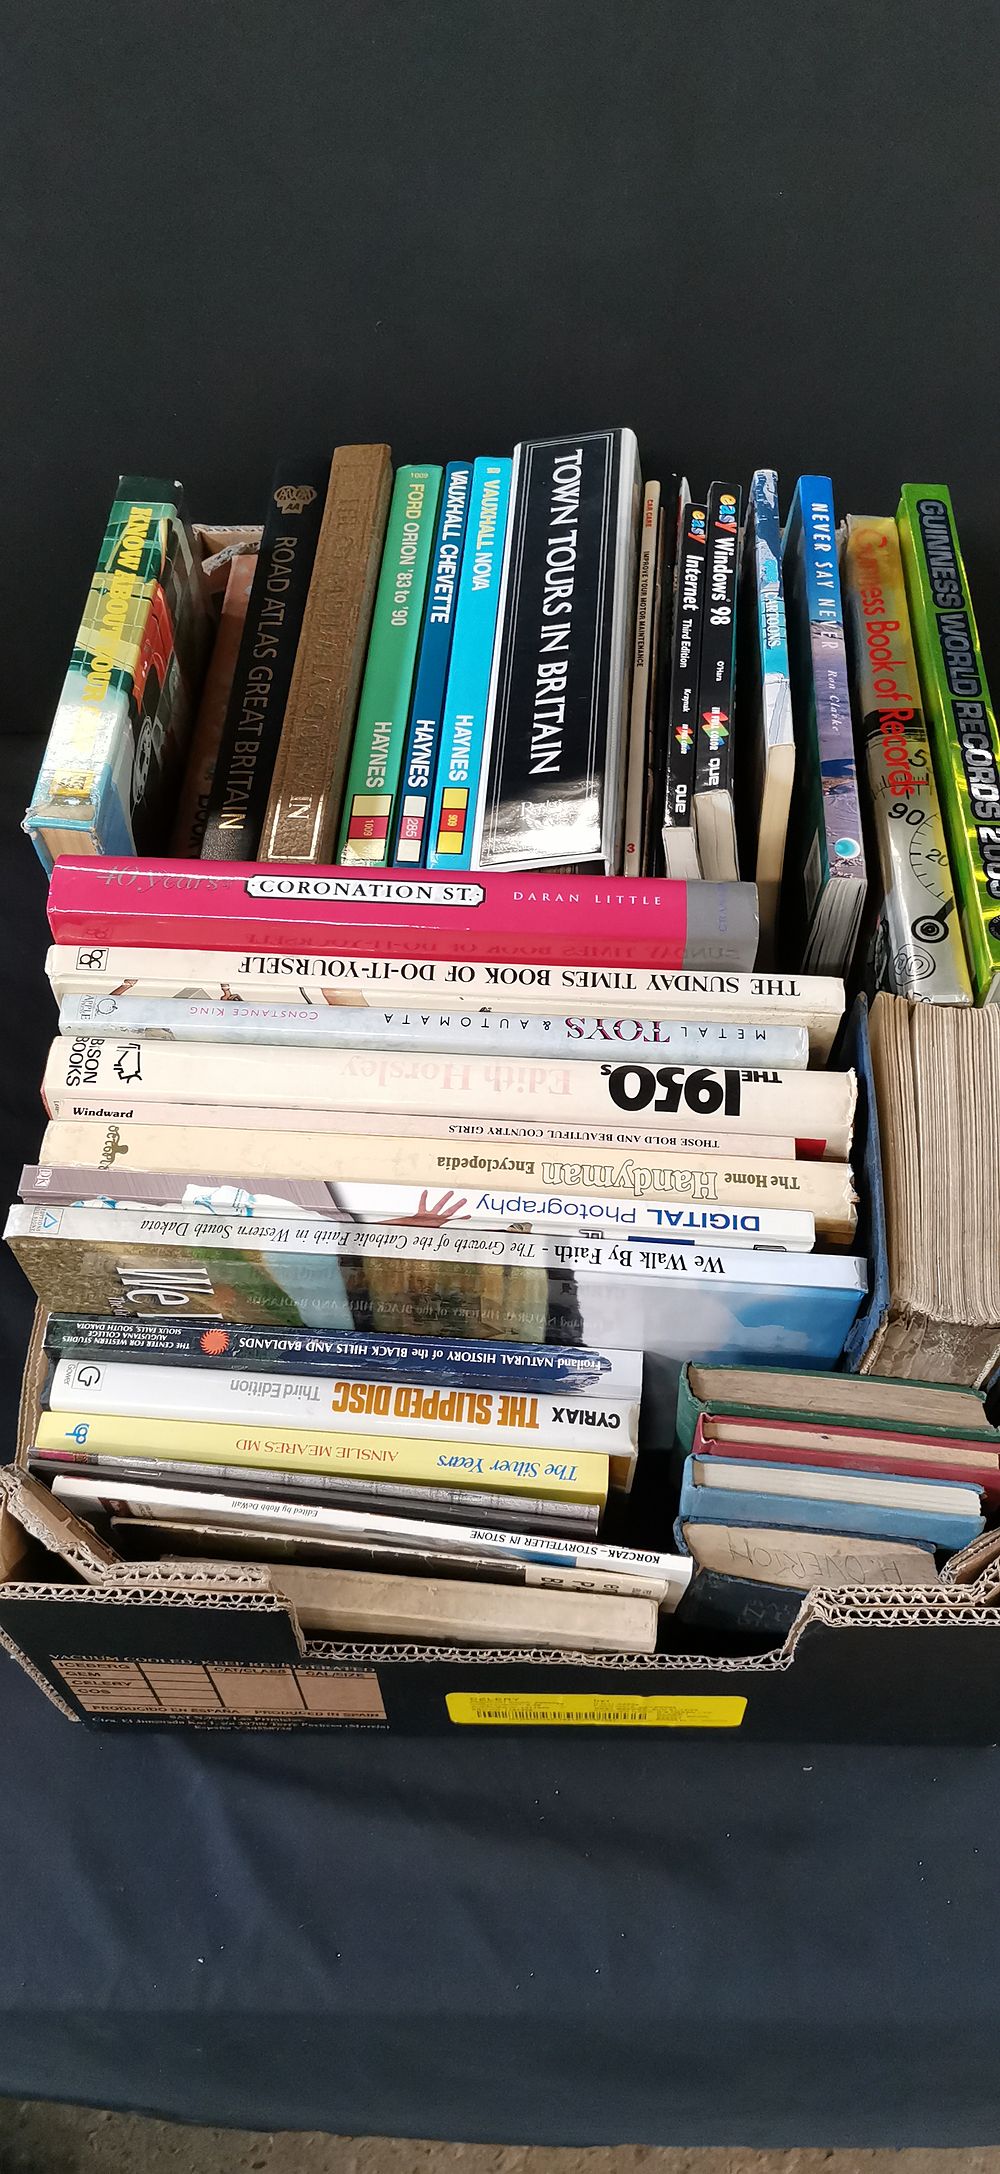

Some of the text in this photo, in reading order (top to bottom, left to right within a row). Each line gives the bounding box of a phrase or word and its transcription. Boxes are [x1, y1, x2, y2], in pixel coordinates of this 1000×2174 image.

[405, 483, 425, 520] FORD
[476, 479, 500, 551] VAUXHALL
[715, 493, 737, 533] easy
[399, 523, 420, 566] ORION
[430, 470, 469, 625] VAUXHALL CHEVETTE
[100, 506, 153, 641] KNOW ABOUT
[266, 536, 298, 593] ROAD
[471, 552, 493, 592] NOVA
[811, 502, 839, 650] NEVER SAY NEVER
[394, 590, 411, 604] to
[679, 509, 706, 668] easy Internet Third Edition
[529, 449, 583, 776] TOWN TOURS IN BRITAIN
[639, 597, 647, 619] MOTOR
[709, 606, 732, 626] 98
[252, 597, 285, 659] ATLAS
[636, 619, 646, 667] MAINTENANCE
[715, 660, 725, 682] O'Hara
[855, 527, 929, 798] Guinness Book of Records
[919, 499, 1000, 820] GUINNESS WORLD RECORDS
[237, 665, 273, 737] GREAT
[827, 669, 840, 732] Ron Clarke
[365, 721, 393, 789] HAYNES
[407, 719, 437, 788] HAYNES
[448, 714, 475, 783] HAYNES
[218, 741, 260, 830] BRITAIN
[405, 817, 420, 838] 285
[888, 802, 925, 826] 90
[626, 842, 636, 854] 3
[259, 879, 473, 901] CORONATION ST.
[513, 890, 661, 906] DARAN LITTLE
[238, 955, 802, 997] THE SUNDAY TIMES BOOK OF DO-IT-YOURSELF
[189, 1005, 319, 1021] CONSTANCE KING
[384, 1012, 530, 1030] AUTOMATA
[564, 1017, 671, 1043] TOYS
[680, 1026, 767, 1041] METAL
[66, 1036, 91, 1087] BOOKS
[83, 1038, 105, 1085] BISON
[340, 1055, 574, 1096] Edith Horsley
[741, 1069, 782, 1084] THE
[72, 1107, 134, 1119] Windward
[448, 1124, 720, 1149] THOSE BOLD AND BEAUTIFUL COUNTRY GIRLS
[34, 1168, 53, 1188] DK
[437, 1155, 800, 1200] The Home Handyman Encyclopedia
[476, 1192, 761, 1232] DIGITAL Photography
[140, 1219, 726, 1274] We Walk By Faith The Growth of the Catholic Faith in Western South Dakota
[116, 1267, 215, 1307] We
[62, 1335, 190, 1350] THE CENTER FOR WESTERN STUDIES
[76, 1322, 182, 1335] SIOUX FALLS, SOUTH DAKOTA
[88, 1330, 168, 1341] AUGUSTANA COLLEGE
[238, 1337, 602, 1370] Froiland NATURAL HISTORY of the BLACK HILLS AND BADLANDS
[230, 1379, 321, 1402] Third Edition
[331, 1381, 621, 1430] CYRIAX THE SLIPPED DISC
[236, 1438, 399, 1463] AINSLIE MEARES MD
[436, 1454, 579, 1482] The Silver Years
[231, 1500, 319, 1518] Edited by Robb DeWall
[469, 1529, 661, 1565] KORCZAK STORYTELLER IN STONE
[49, 1653, 376, 1673] VACUUM KEEP REFRIGERATED
[58, 1661, 131, 1670] ICEBERG
[65, 1670, 101, 1678] GEM
[71, 1679, 133, 1688] CELERY
[77, 1687, 112, 1695] COS
[92, 1704, 169, 1713] PRODUCIDO
[254, 1709, 324, 1718] PRODUCED
[343, 1711, 380, 1719] SPAIN
